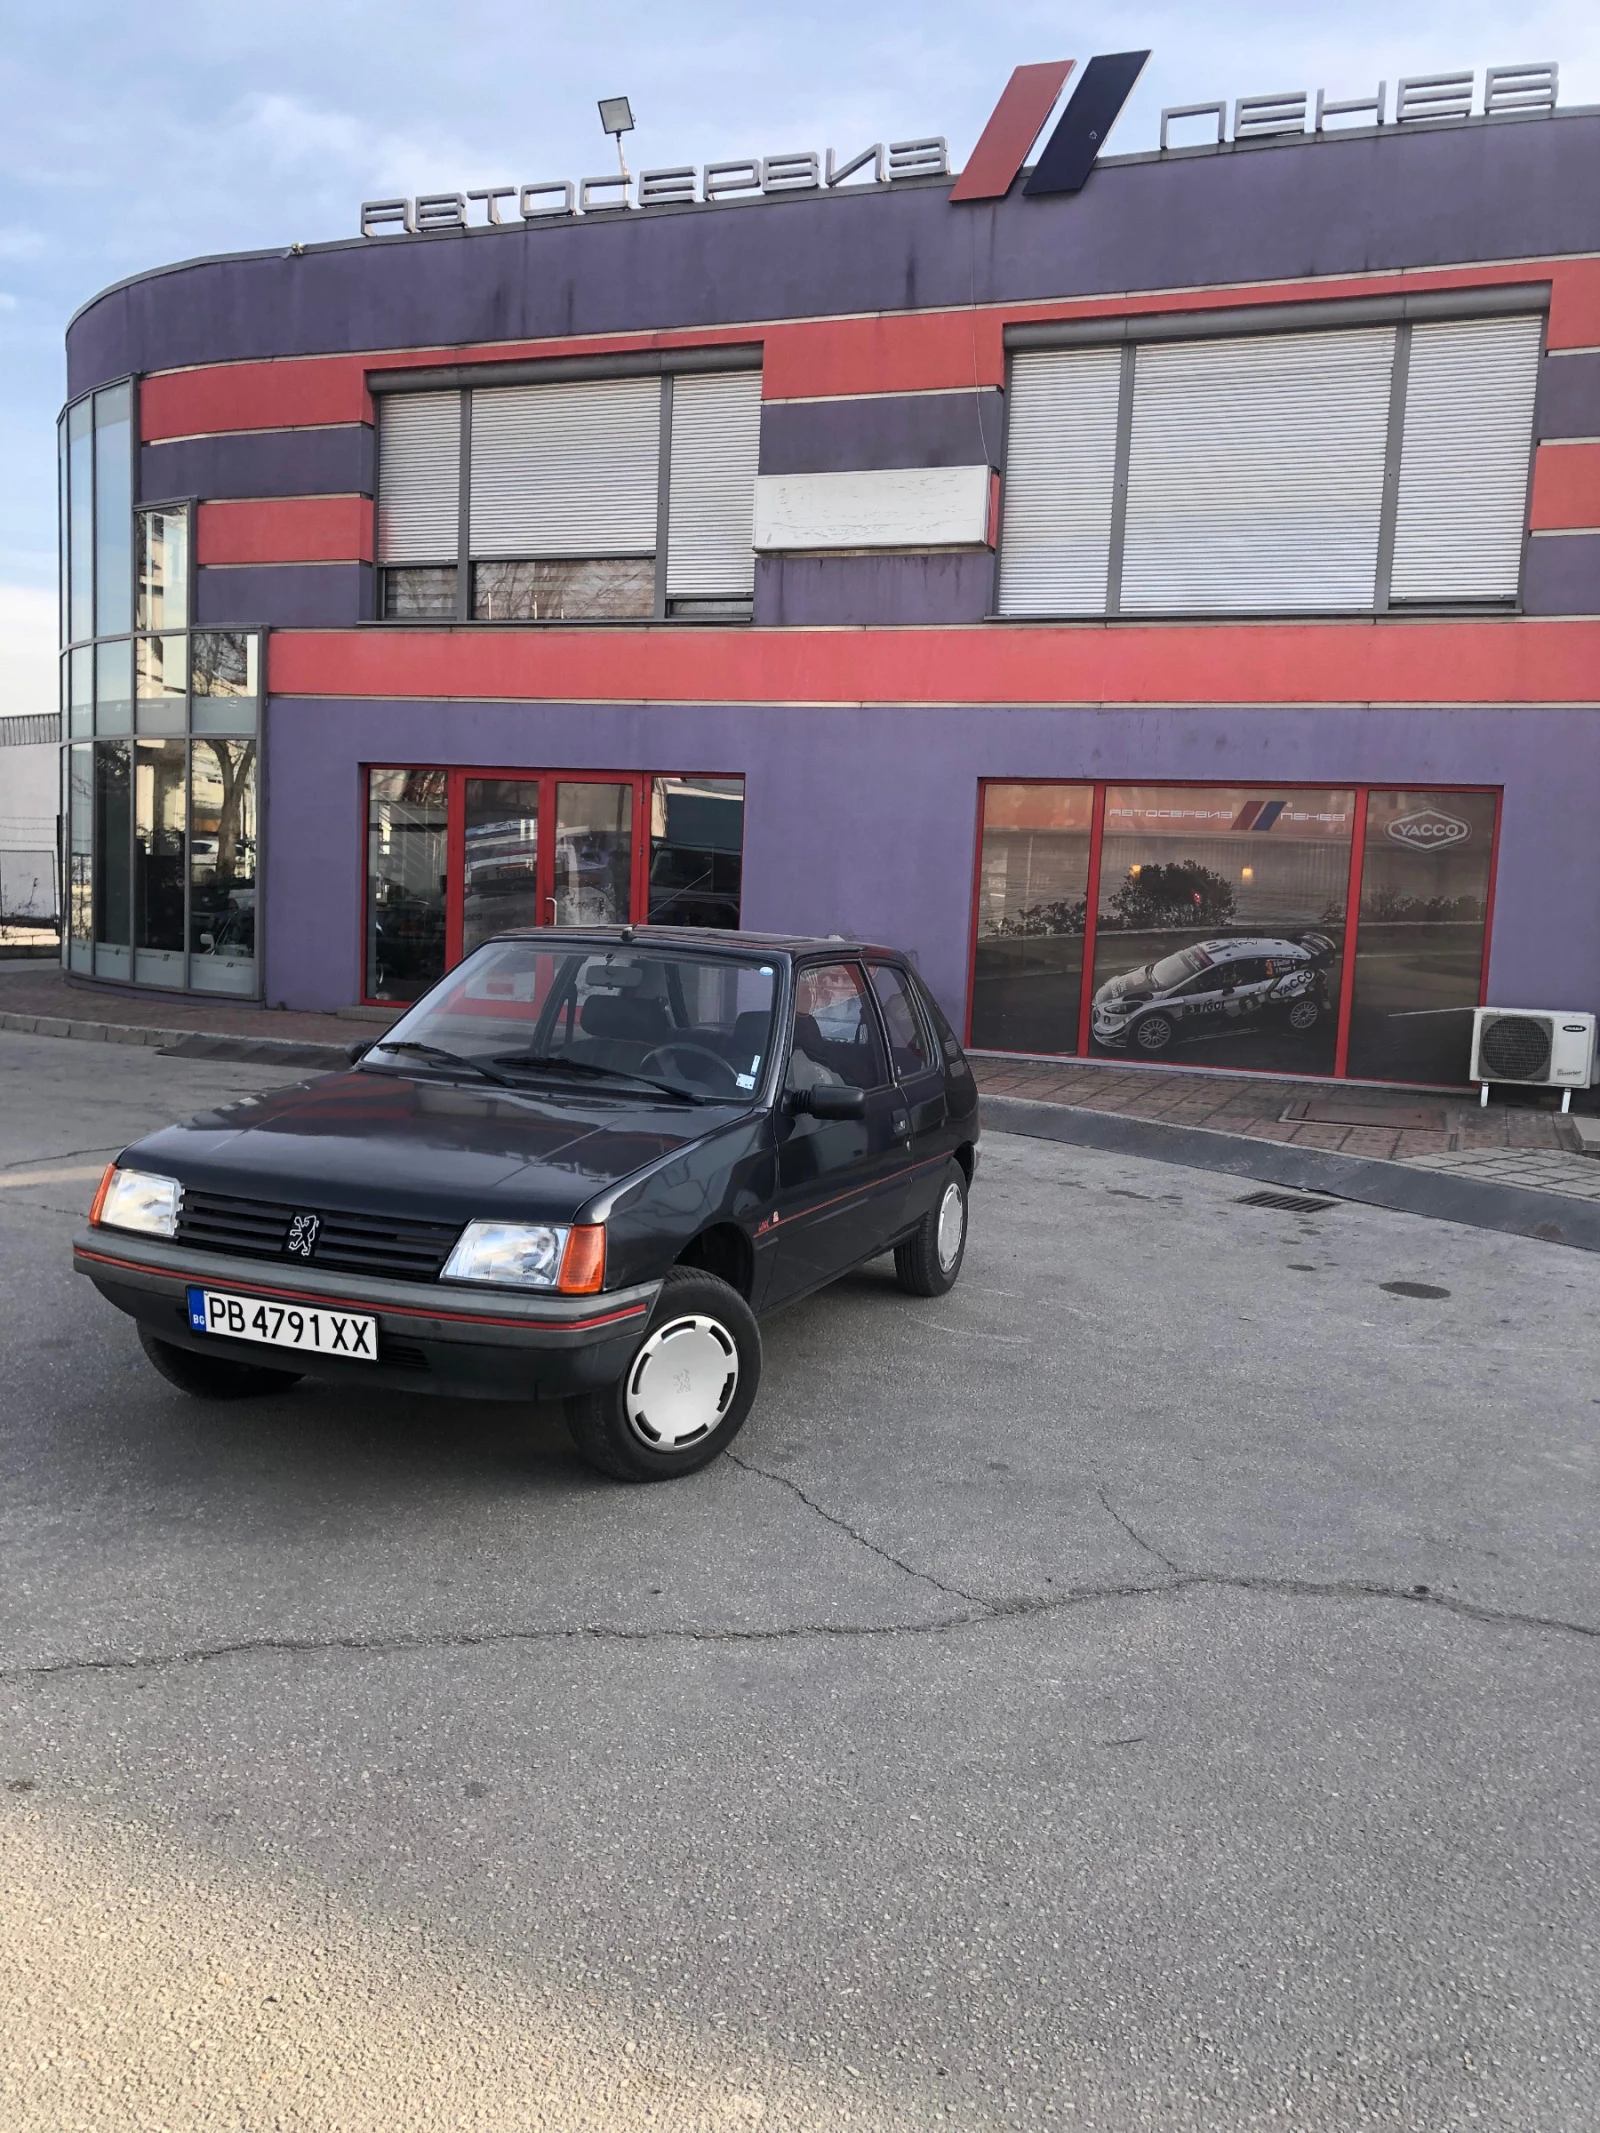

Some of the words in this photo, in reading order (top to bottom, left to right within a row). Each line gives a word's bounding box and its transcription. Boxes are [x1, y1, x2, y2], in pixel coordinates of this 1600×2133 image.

[361, 136, 952, 237] АВТОСЕРВИЗ
[1160, 61, 1559, 150] ПЕНЕВ
[1108, 808, 1233, 820] АВТОСЕРВИЗ
[1280, 811, 1346, 822] ПЕНЕВ
[1398, 823, 1459, 837] YACCO
[1275, 970, 1313, 996] YACCO
[193, 1313, 205, 1326] BG
[208, 1296, 246, 1333] PB
[251, 1305, 321, 1347] 4791
[331, 1316, 371, 1355] XX
